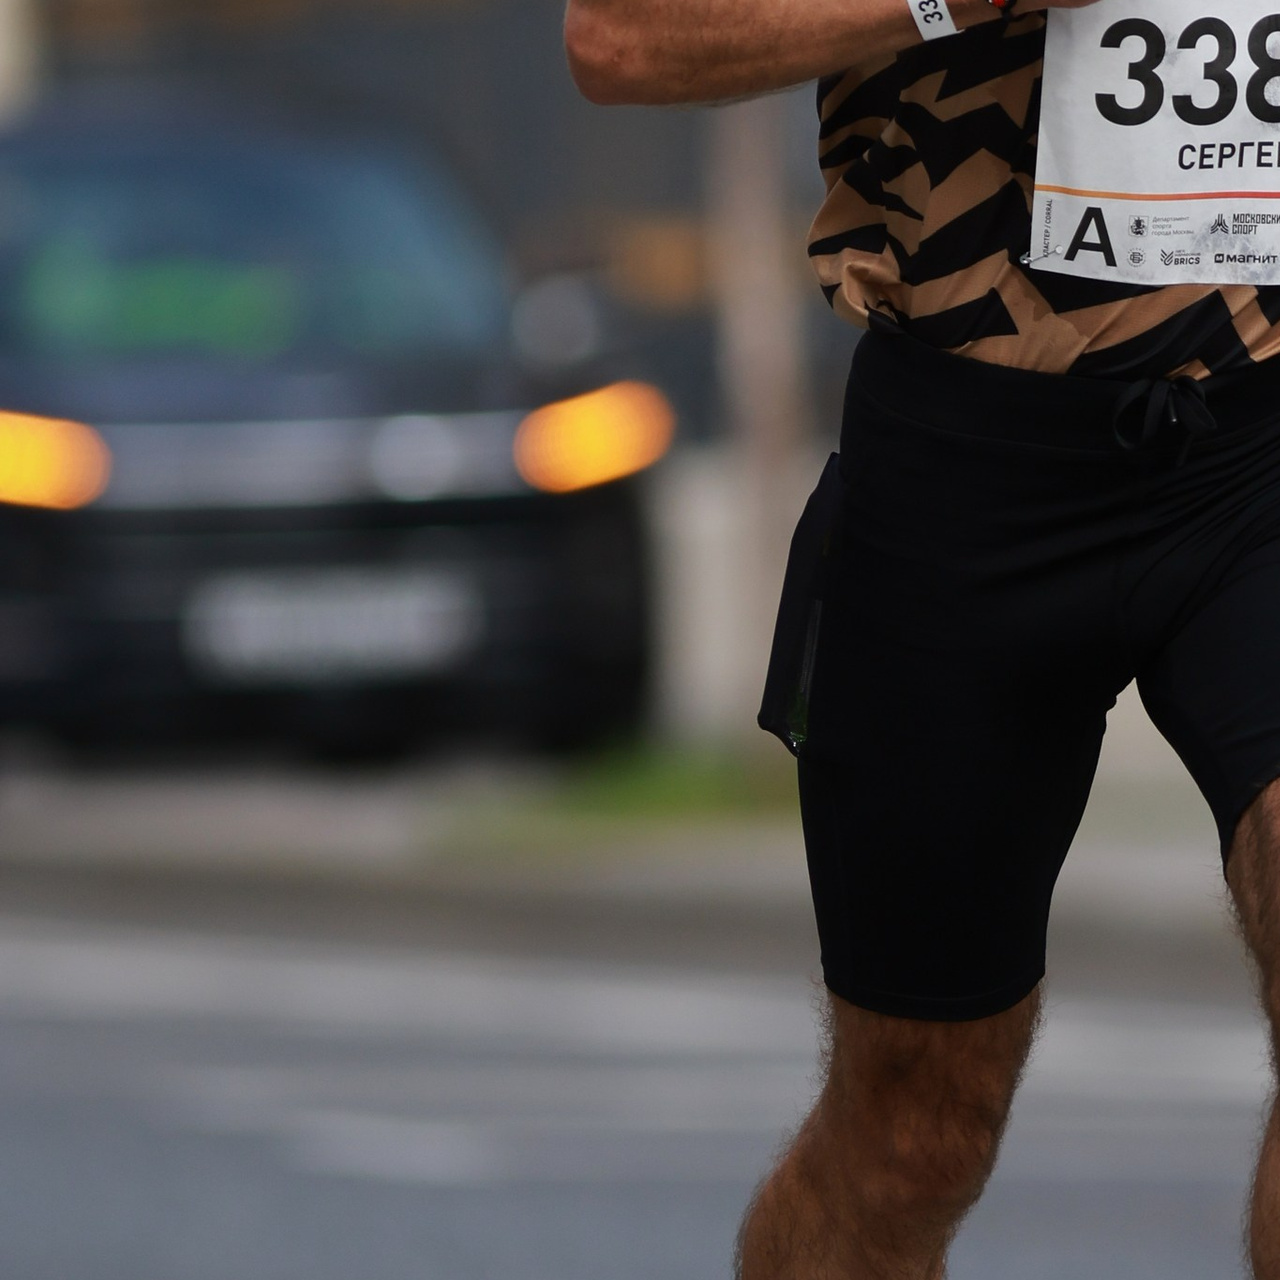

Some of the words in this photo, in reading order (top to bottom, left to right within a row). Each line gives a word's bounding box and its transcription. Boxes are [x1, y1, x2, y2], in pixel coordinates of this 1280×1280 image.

[1044, 199, 1053, 224] CORRAL
[1232, 225, 1259, 235] СПОРТ
[1064, 206, 1118, 268] A
[1173, 257, 1201, 266] BRICS
[1226, 254, 1278, 264] магнит
